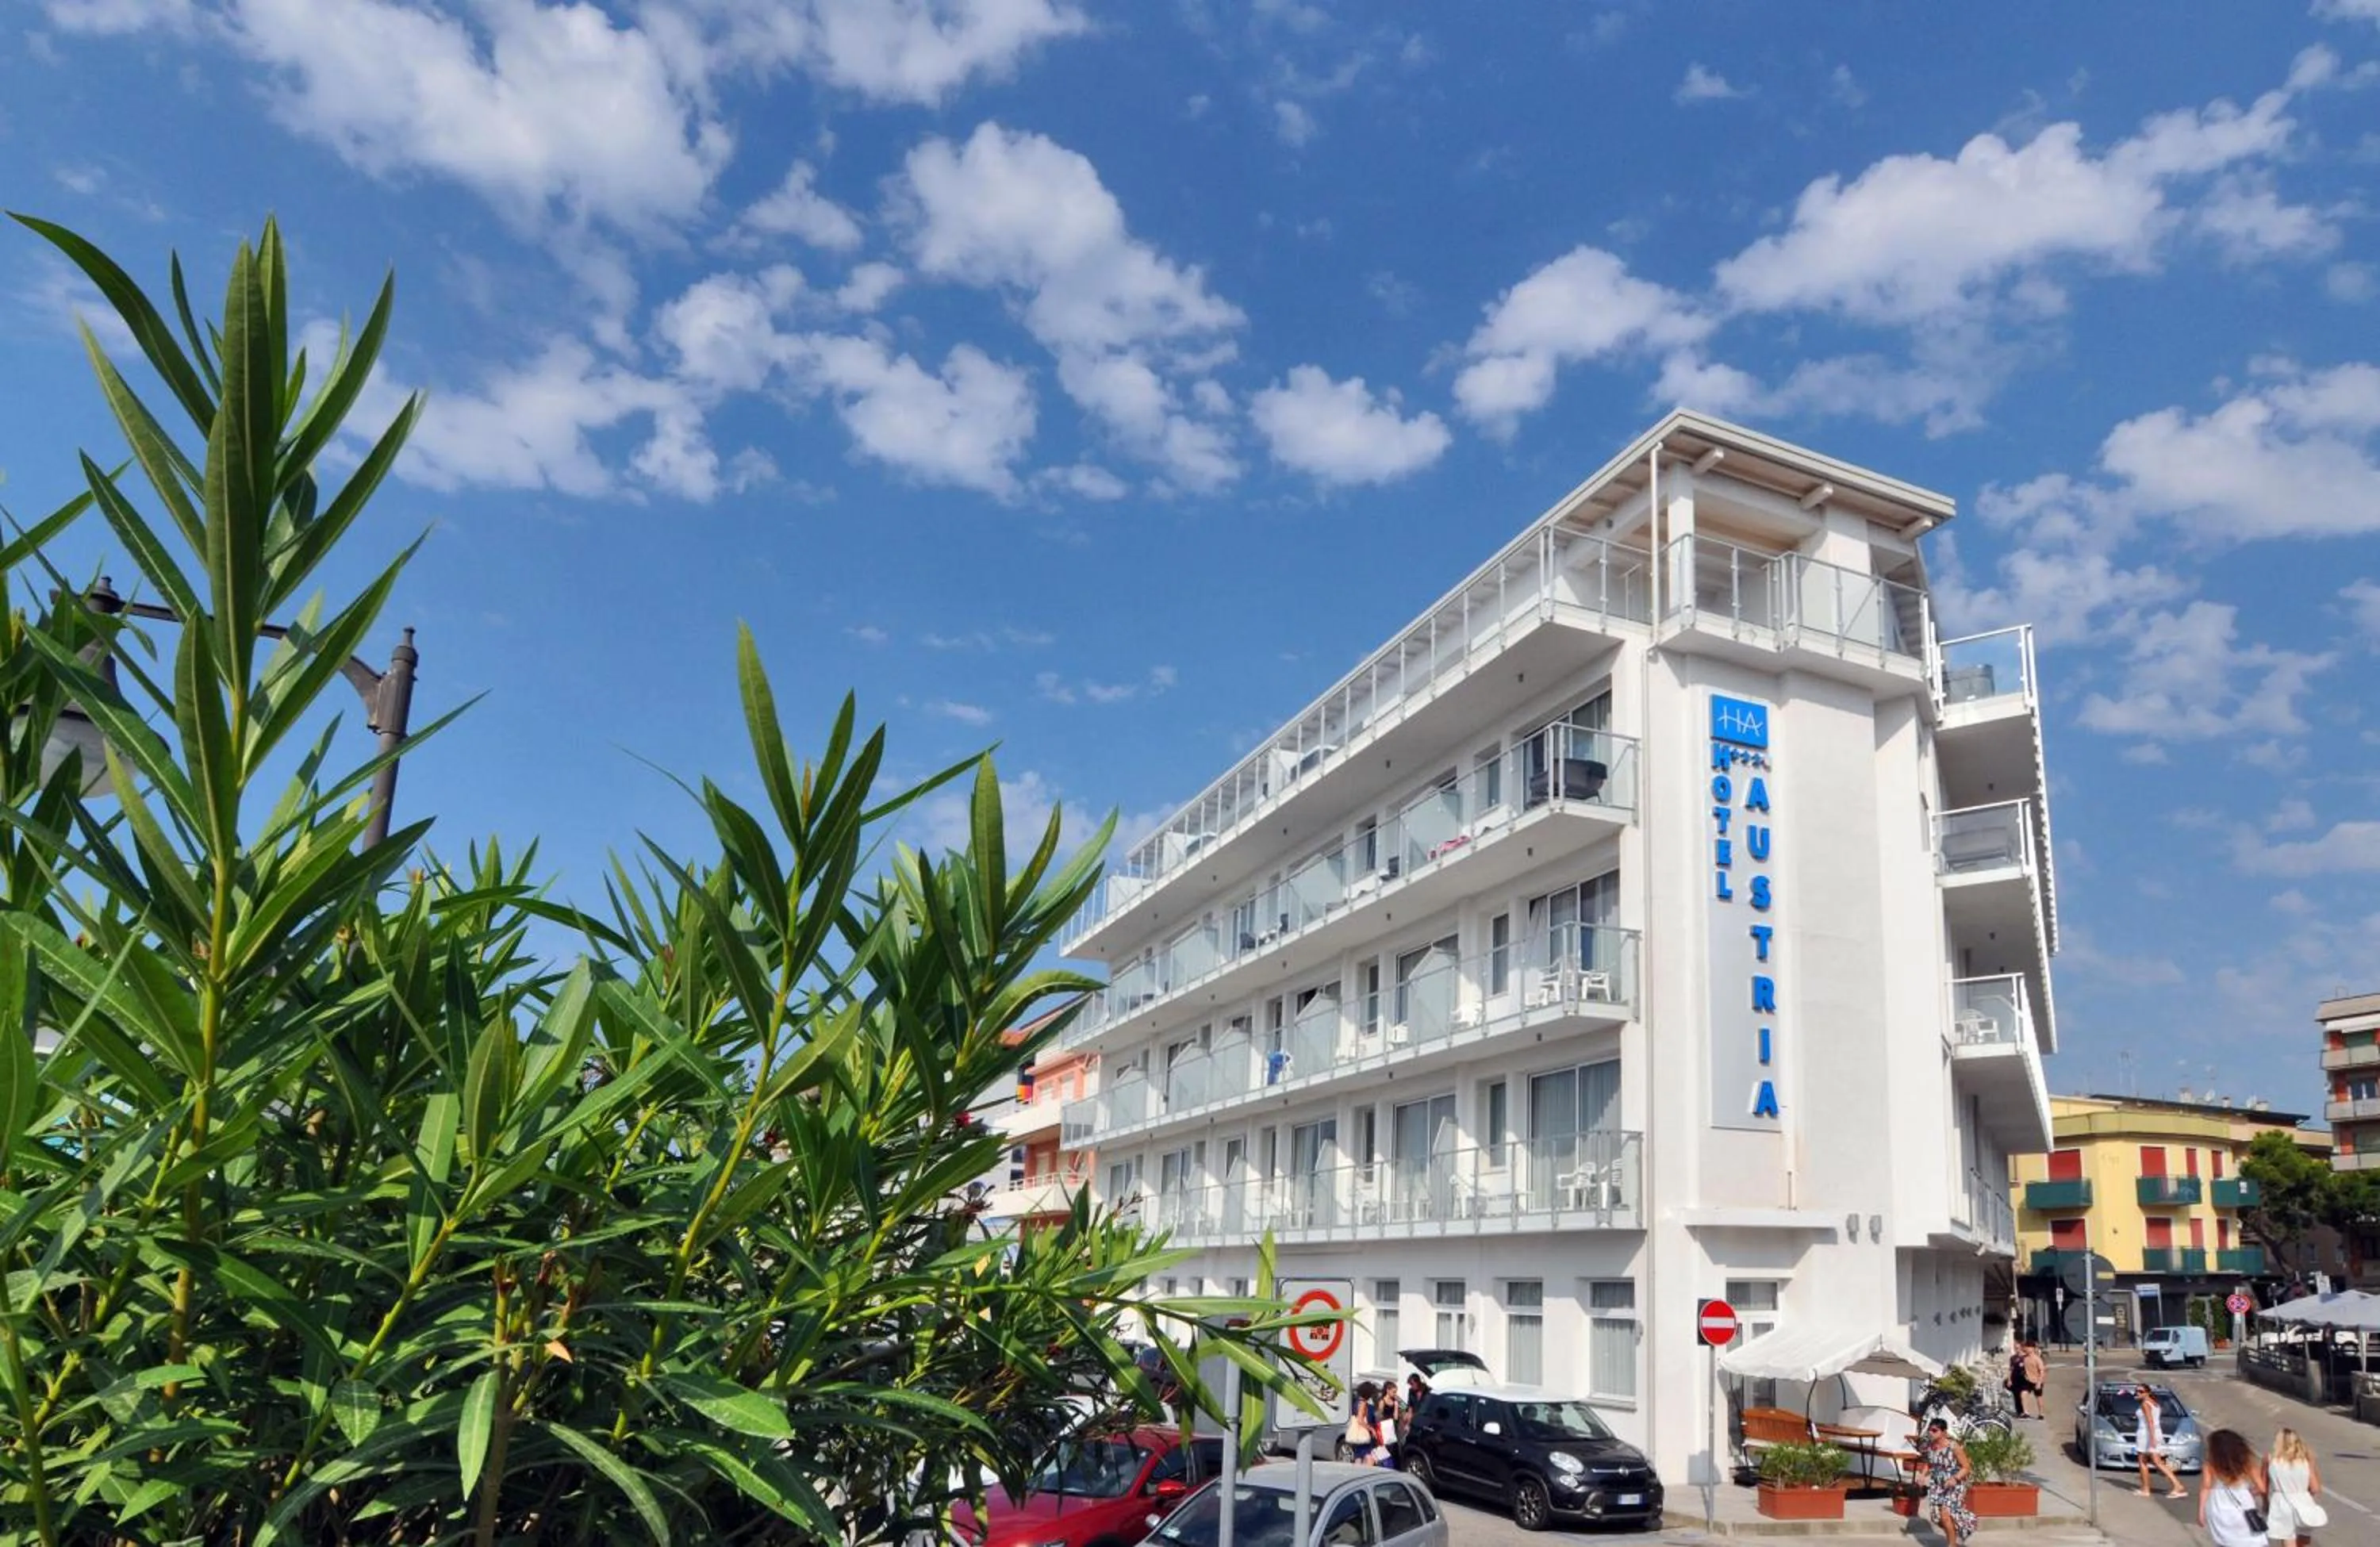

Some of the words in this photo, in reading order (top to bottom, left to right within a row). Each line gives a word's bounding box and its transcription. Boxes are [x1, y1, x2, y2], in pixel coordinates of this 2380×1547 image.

[1717, 704, 1764, 737] HA
[1711, 743, 1733, 900] HOTEL
[1746, 777, 1778, 1118] AUSTRIA
